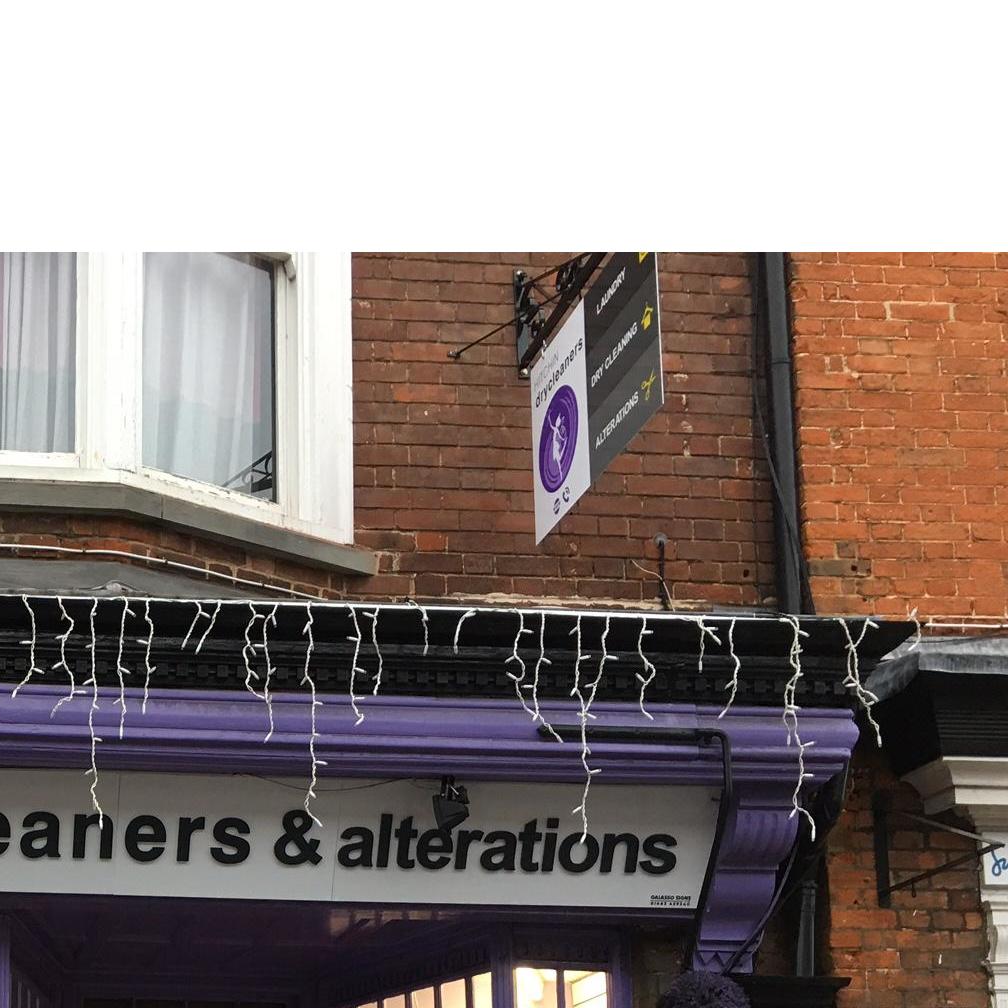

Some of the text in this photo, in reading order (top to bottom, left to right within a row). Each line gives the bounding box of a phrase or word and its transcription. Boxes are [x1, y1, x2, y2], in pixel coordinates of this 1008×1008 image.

[596, 267, 627, 315] LAUNDRY
[535, 338, 584, 408] drycleaners
[591, 322, 639, 388] DRY CLEANING
[595, 391, 640, 449] ALTERATIONS
[273, 808, 324, 866] &
[337, 812, 678, 875] alterations
